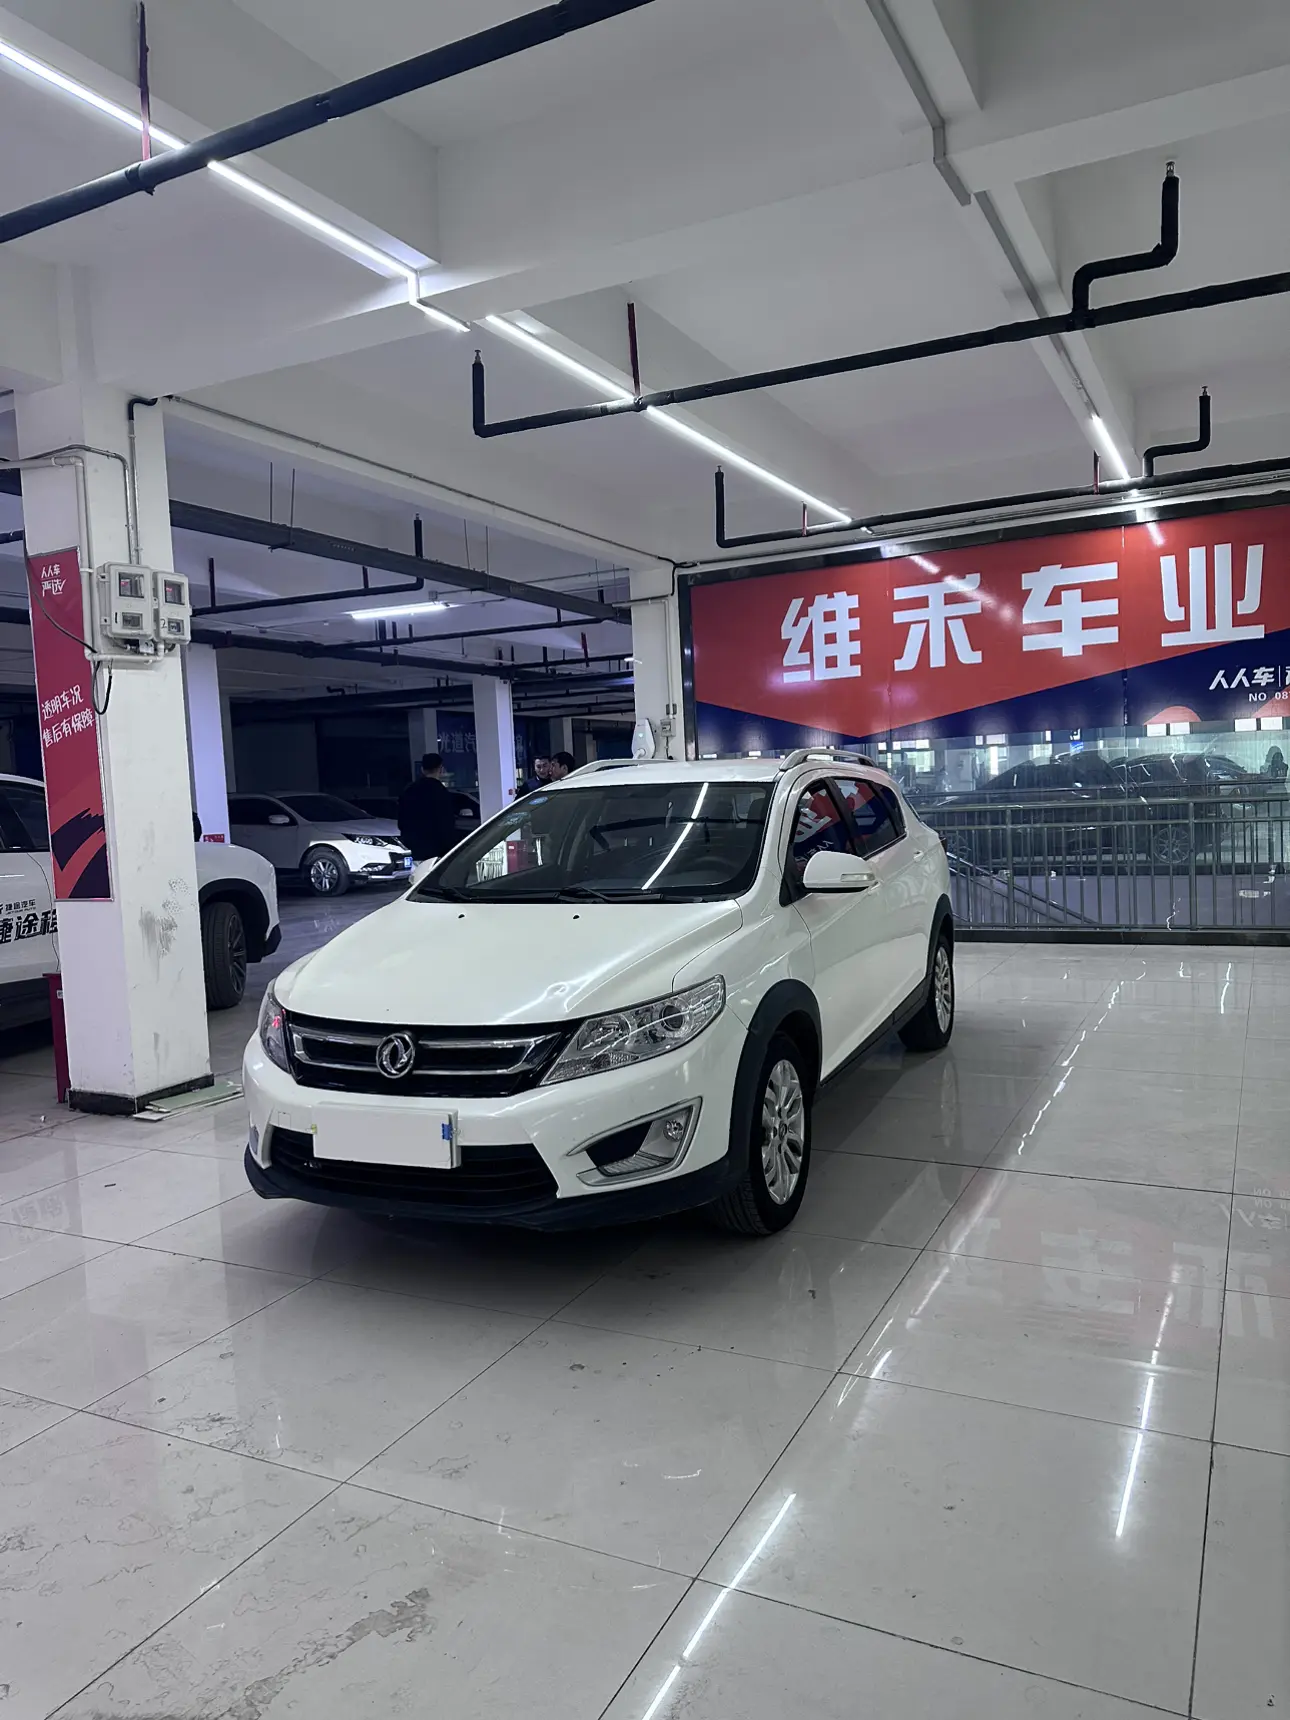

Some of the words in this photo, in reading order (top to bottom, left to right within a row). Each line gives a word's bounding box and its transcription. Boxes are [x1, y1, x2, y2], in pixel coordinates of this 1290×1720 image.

[41, 564, 60, 578] 人人车
[41, 579, 66, 597] 严选
[781, 543, 1265, 683] 维禾车业
[1209, 666, 1275, 690] 人人车
[41, 684, 84, 721] 透明车况
[1248, 692, 1267, 702] NO
[1274, 691, 1290, 700] 08
[43, 708, 94, 748] 售后有保障
